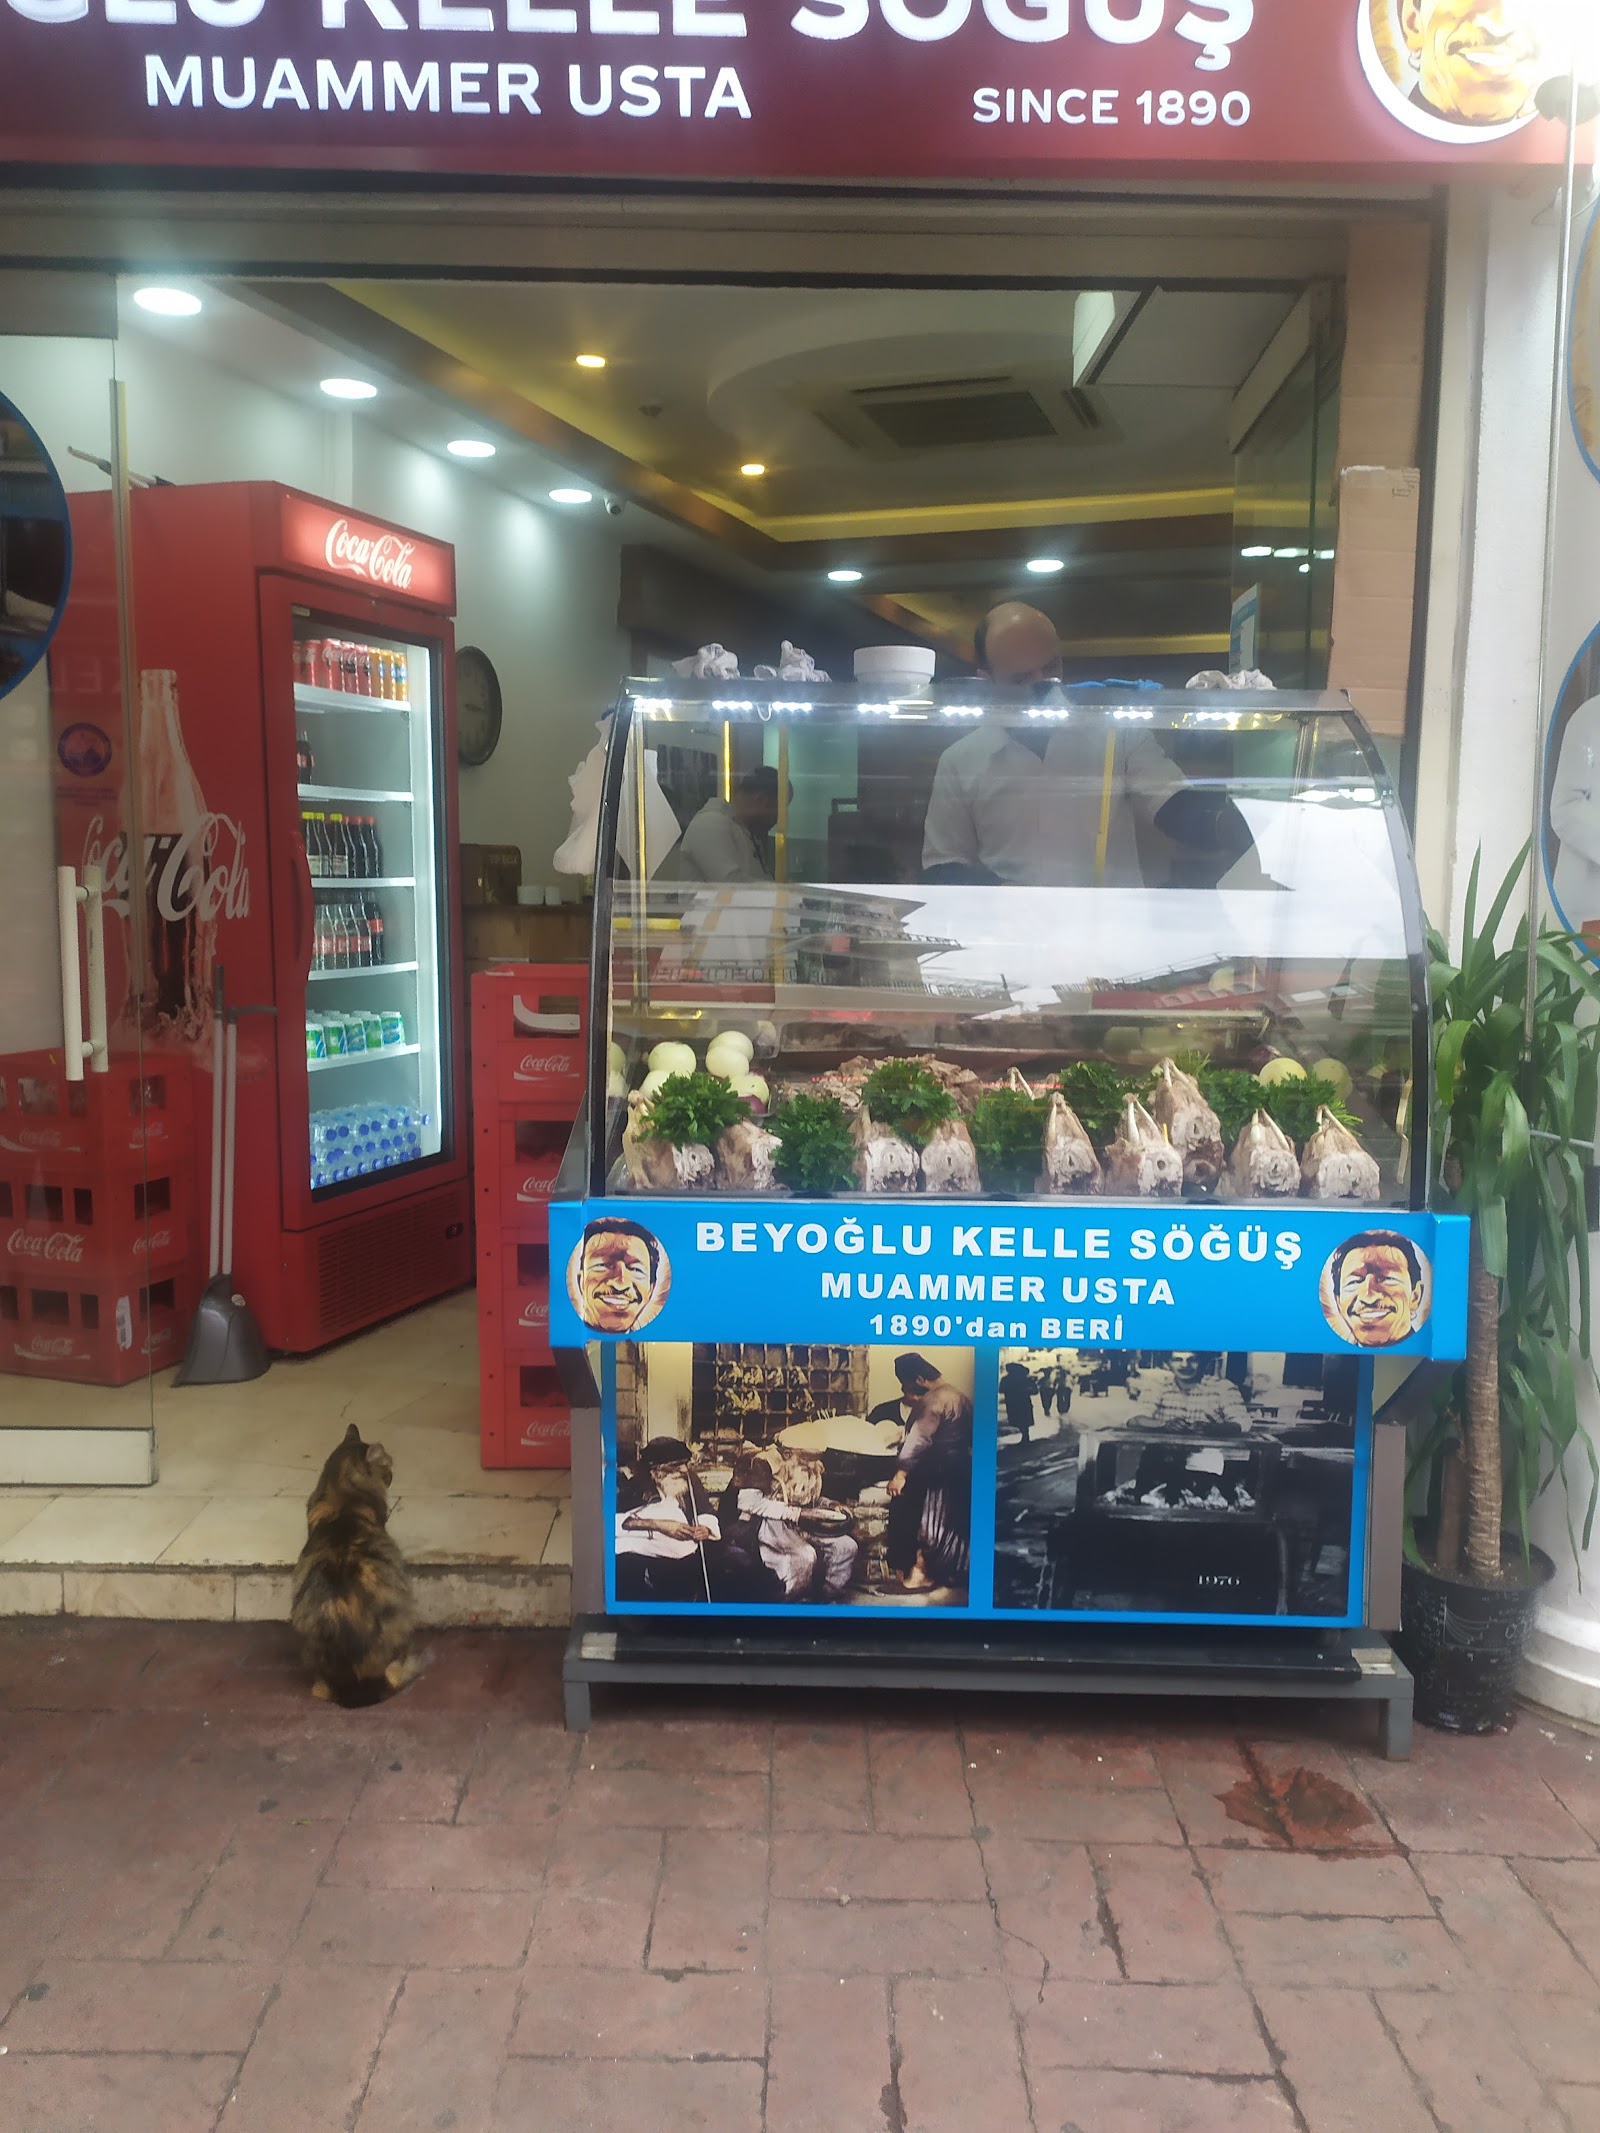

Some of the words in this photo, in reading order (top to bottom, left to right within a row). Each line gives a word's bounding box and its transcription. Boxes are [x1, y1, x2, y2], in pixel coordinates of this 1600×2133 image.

[145, 54, 542, 114] MUAMMER
[568, 64, 752, 119] USTA
[972, 87, 1120, 125] SINCE
[1136, 89, 1252, 127] 1890
[325, 519, 416, 589] Coca-Cola
[520, 1054, 571, 1072] Coca-Cola
[7, 1229, 85, 1262] Coca-Cola
[696, 1217, 932, 1256] BEYOĞLU
[952, 1226, 1111, 1259] KELLE
[1129, 1223, 1302, 1270] SÖĞÜŞ
[821, 1272, 1046, 1303] MUAMMER
[1062, 1276, 1175, 1306] USTA
[869, 1314, 1027, 1339] 1890'dan
[1041, 1314, 1123, 1341] BERİ
